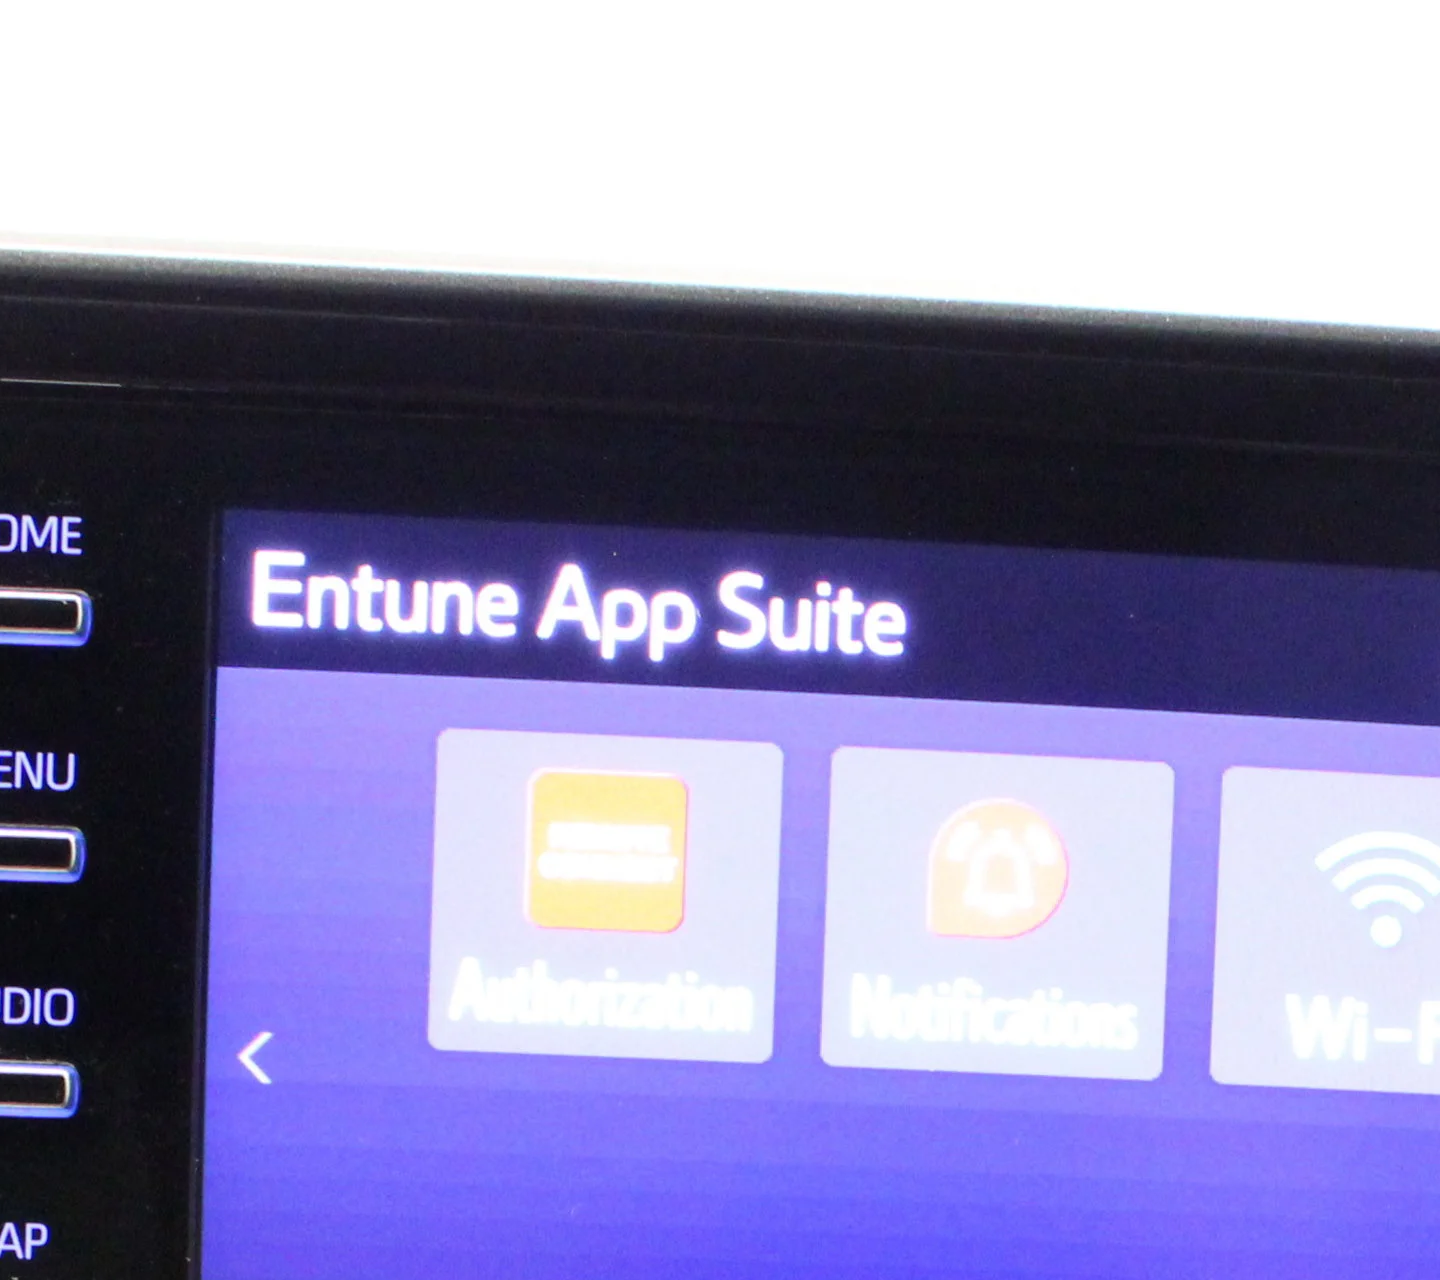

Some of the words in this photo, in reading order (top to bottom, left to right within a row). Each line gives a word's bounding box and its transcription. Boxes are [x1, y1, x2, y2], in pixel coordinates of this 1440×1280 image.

[248, 548, 520, 638] Entune
[535, 562, 698, 661] App
[716, 569, 909, 659] Suite
[448, 956, 754, 1034] Authorization
[850, 971, 1140, 1050] Notifications
